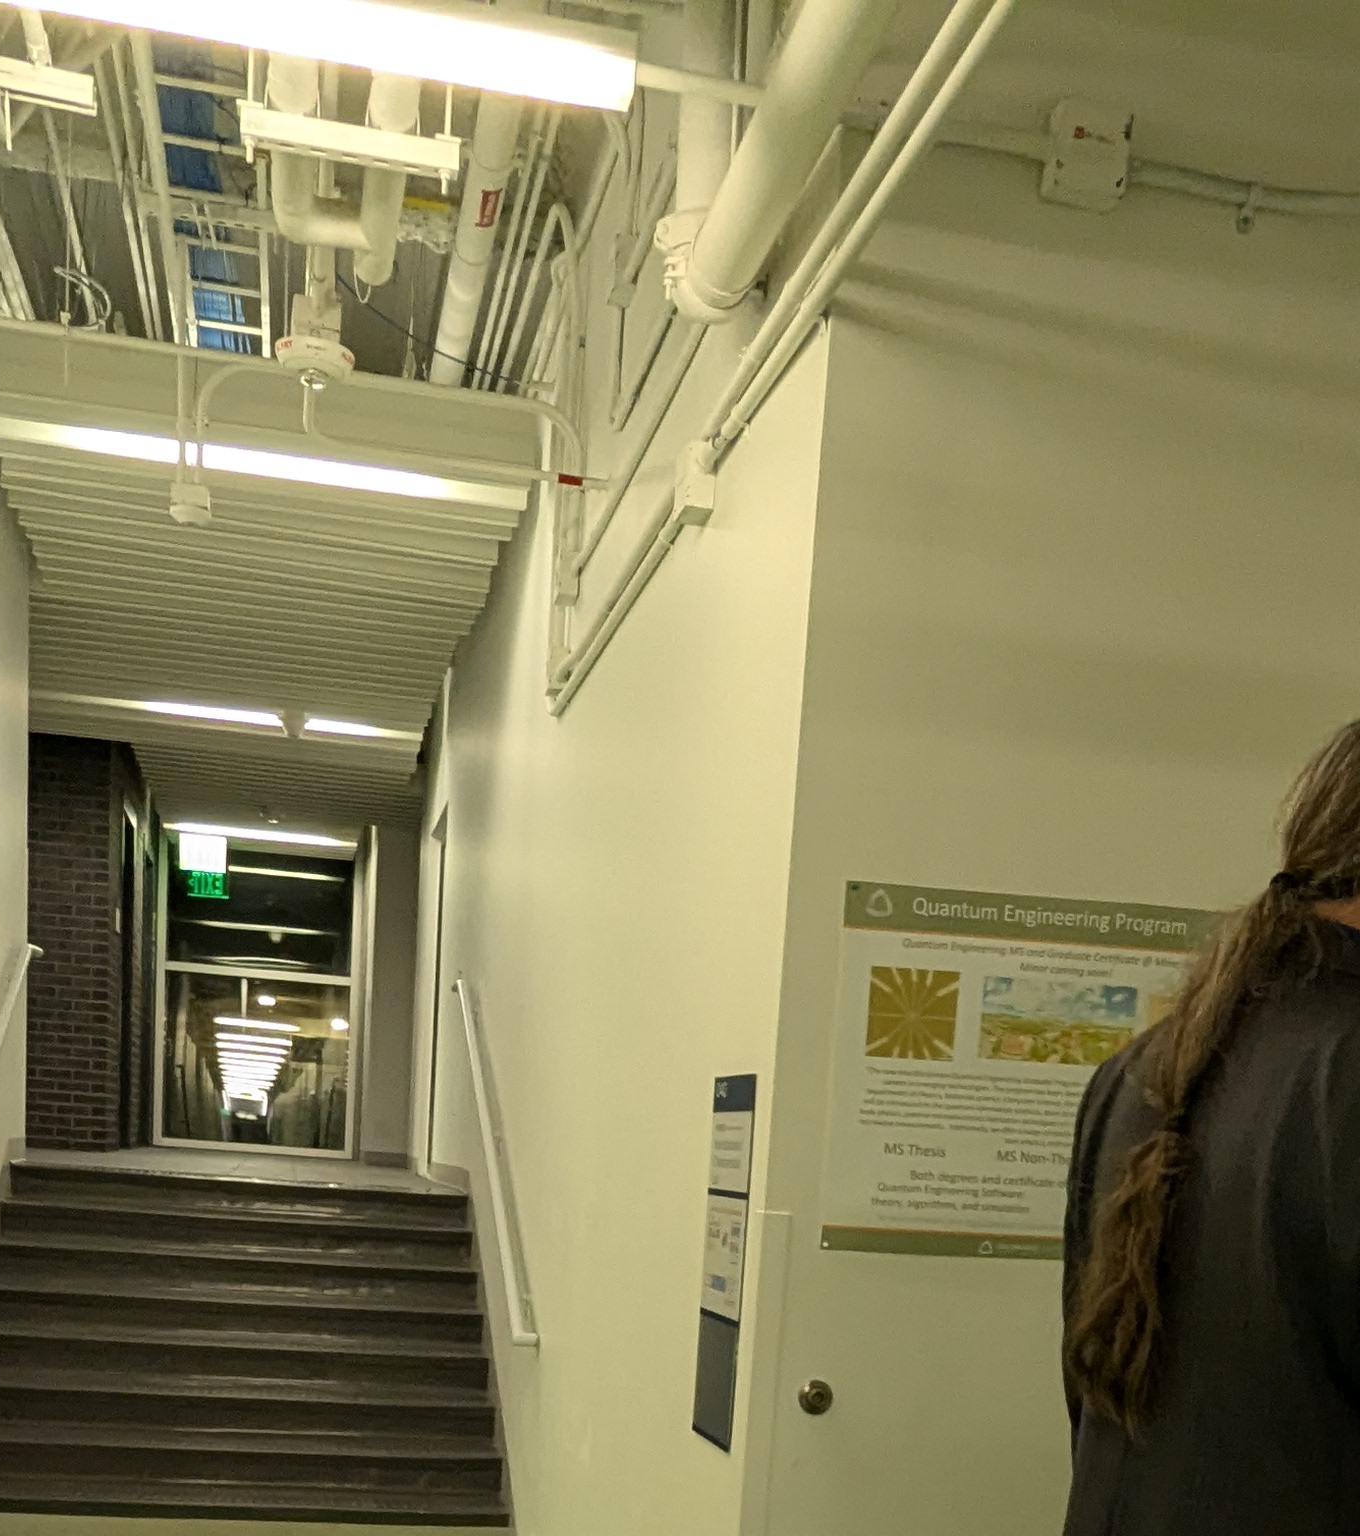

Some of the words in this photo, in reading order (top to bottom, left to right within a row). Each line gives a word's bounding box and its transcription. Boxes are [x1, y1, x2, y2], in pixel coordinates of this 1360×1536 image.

[913, 896, 998, 922] Quantum
[1003, 904, 1111, 933] Engineering
[1116, 913, 1187, 937] Program
[902, 937, 948, 950] Quantum
[951, 941, 1006, 956] Engineering
[1026, 948, 1046, 958] and
[1093, 952, 1140, 966] Certificate
[884, 1142, 905, 1156] MS
[908, 1143, 946, 1158] Thesis
[997, 1149, 1017, 1162] MS
[909, 1169, 936, 1181] Both
[981, 1174, 1001, 1185] and
[877, 1182, 922, 1193] Quantum
[924, 1184, 979, 1199] Engineering
